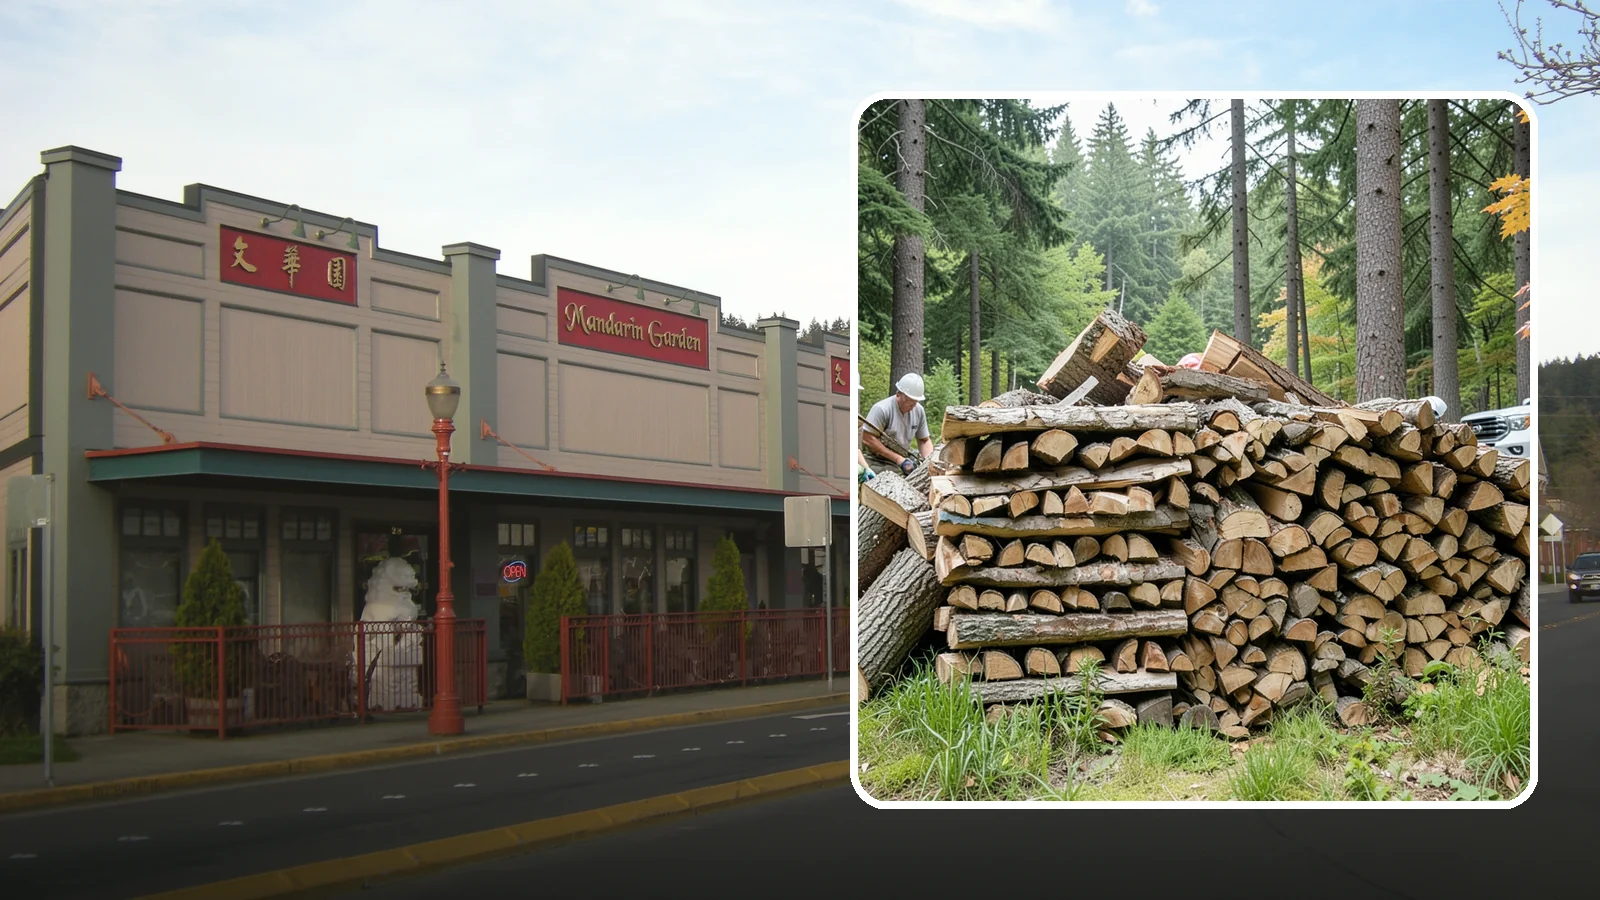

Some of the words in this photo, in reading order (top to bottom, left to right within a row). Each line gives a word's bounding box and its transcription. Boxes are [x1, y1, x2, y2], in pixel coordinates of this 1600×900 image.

[231, 235, 346, 291] 文華園
[564, 302, 644, 341] Mandarin
[648, 320, 702, 352] Garden
[503, 565, 527, 578] OPEN
